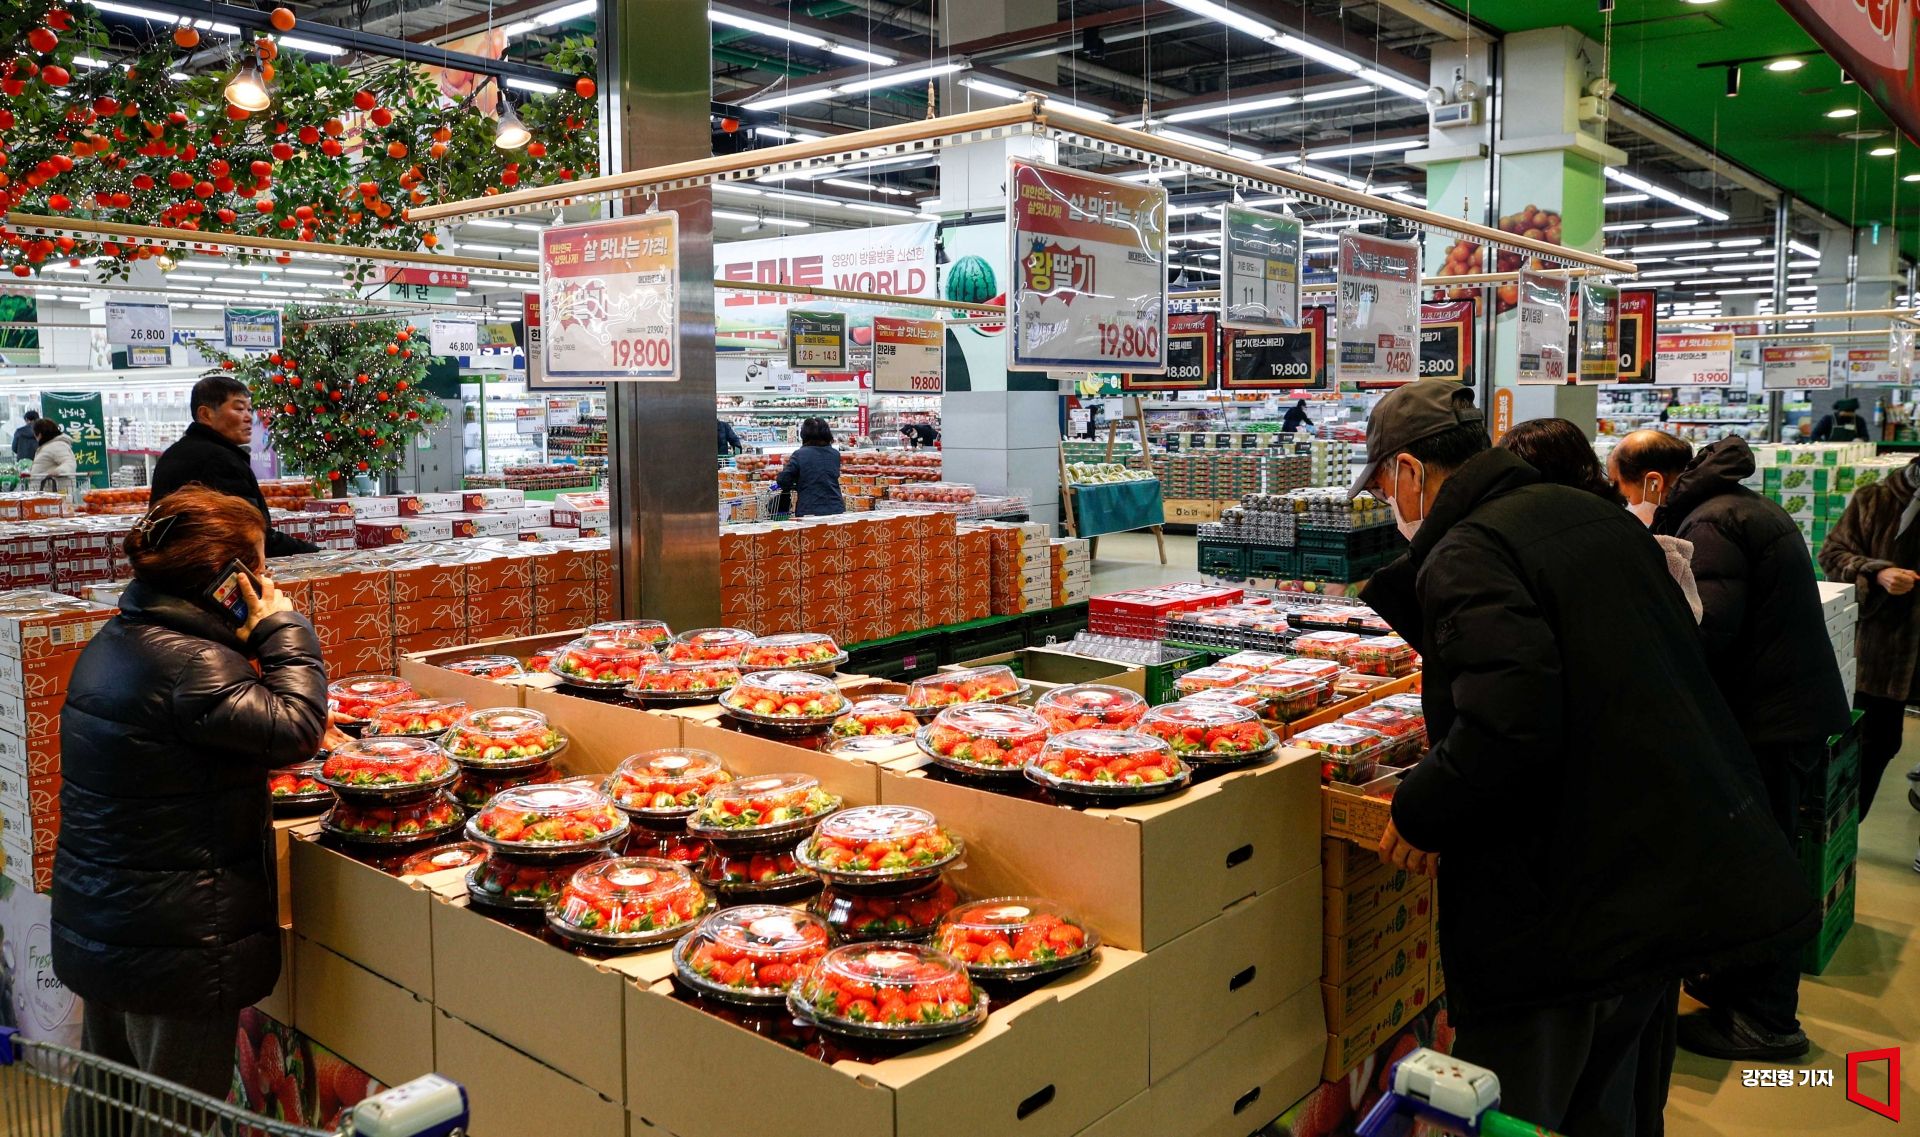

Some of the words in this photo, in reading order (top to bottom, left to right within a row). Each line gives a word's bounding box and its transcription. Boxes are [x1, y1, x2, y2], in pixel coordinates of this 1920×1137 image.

[1069, 193, 1086, 221] 살
[584, 240, 598, 262] 살
[600, 236, 640, 260] 맛나는
[832, 252, 857, 268] 영양이
[859, 247, 895, 266] 방울방울
[897, 246, 925, 262] 신선한
[1029, 252, 1095, 298] 왕딸기
[833, 268, 927, 297] WORLD
[131, 329, 165, 341] 26,800
[1098, 323, 1159, 358] 19,800
[449, 342, 474, 352] 46,800
[1235, 338, 1285, 348] 딸기(킹스베리)
[610, 338, 670, 368] 19,800
[823, 351, 837, 361] 14.3
[877, 345, 896, 355] 한라봉
[1167, 366, 1201, 378] 18,800
[1270, 363, 1308, 376] 19,800
[911, 376, 941, 390] 19,800
[1692, 373, 1728, 383] 13,900
[1796, 377, 1827, 387] 13,900
[58, 419, 102, 443] 물초
